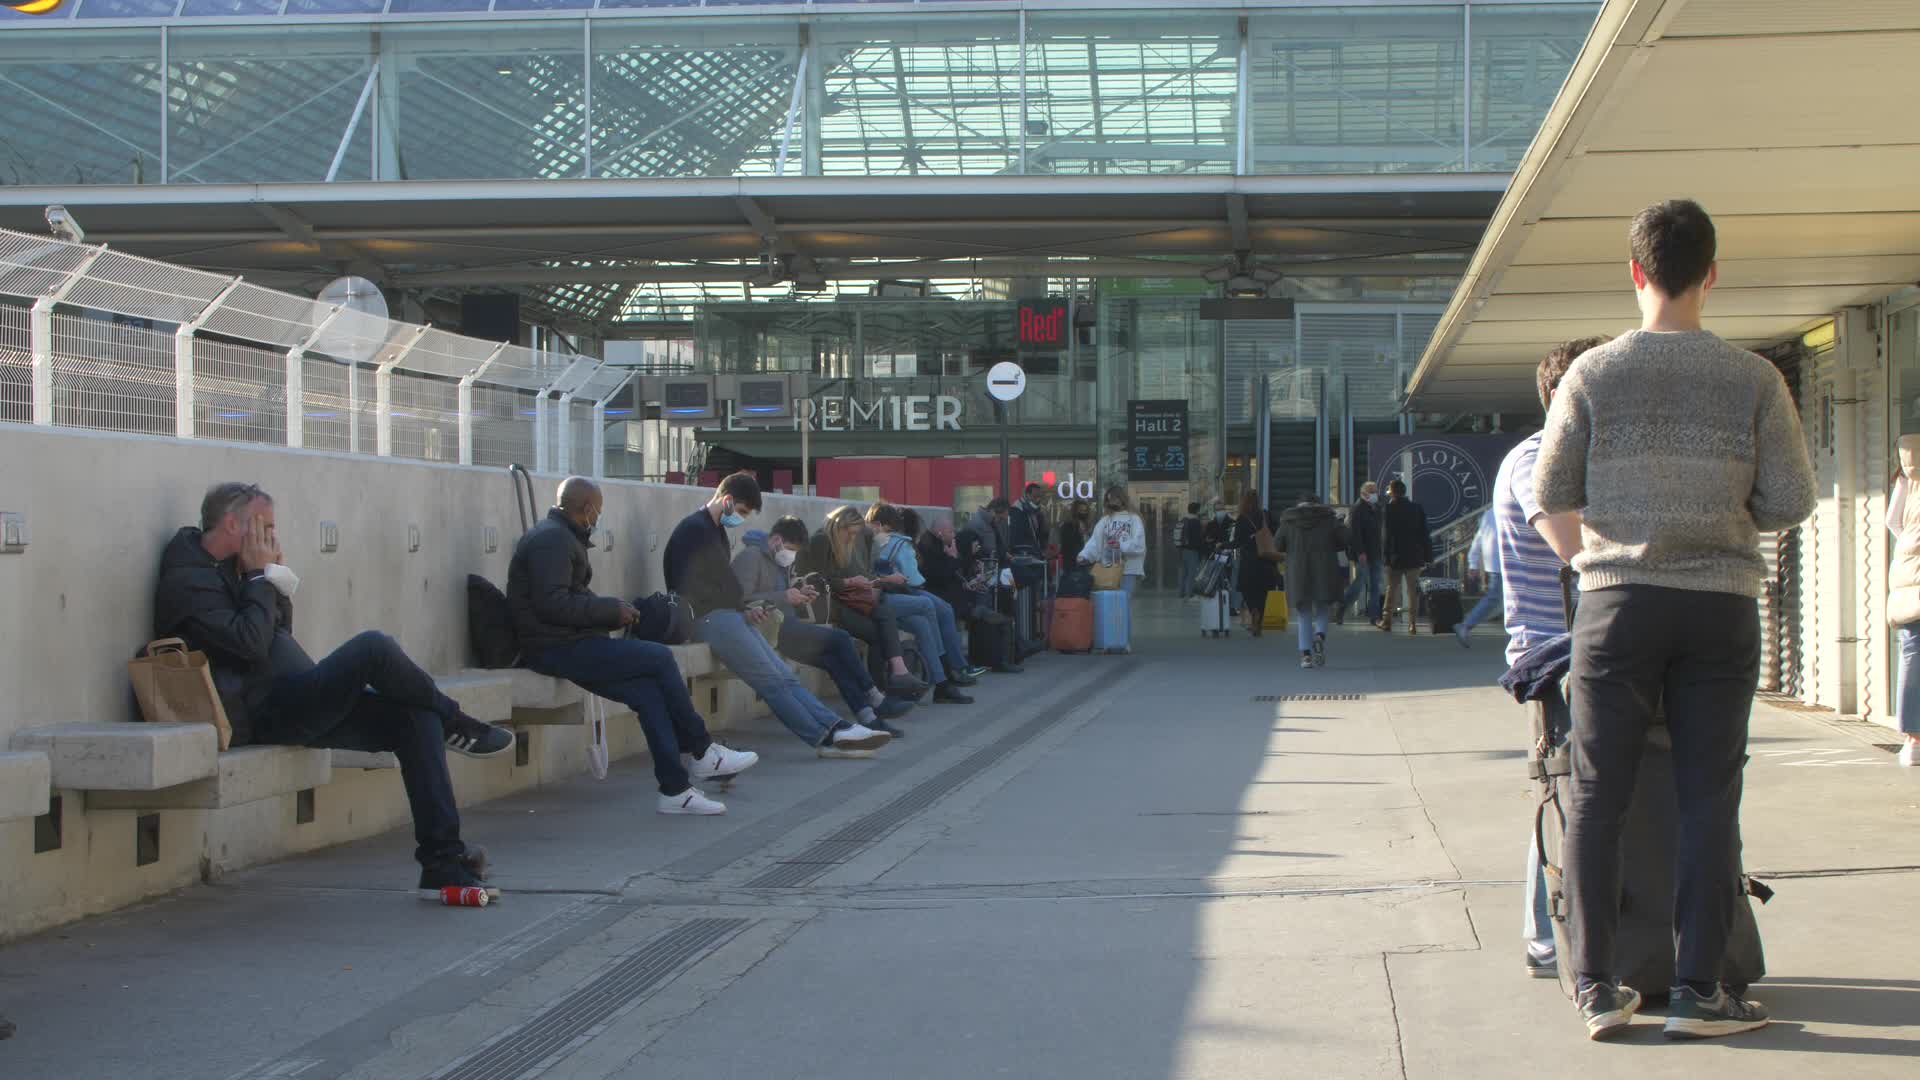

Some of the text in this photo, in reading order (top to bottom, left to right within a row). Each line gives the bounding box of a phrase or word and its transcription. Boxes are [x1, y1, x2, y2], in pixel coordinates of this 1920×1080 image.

[1135, 419, 1182, 432] Hall 2
[1167, 452, 1185, 468] 23
